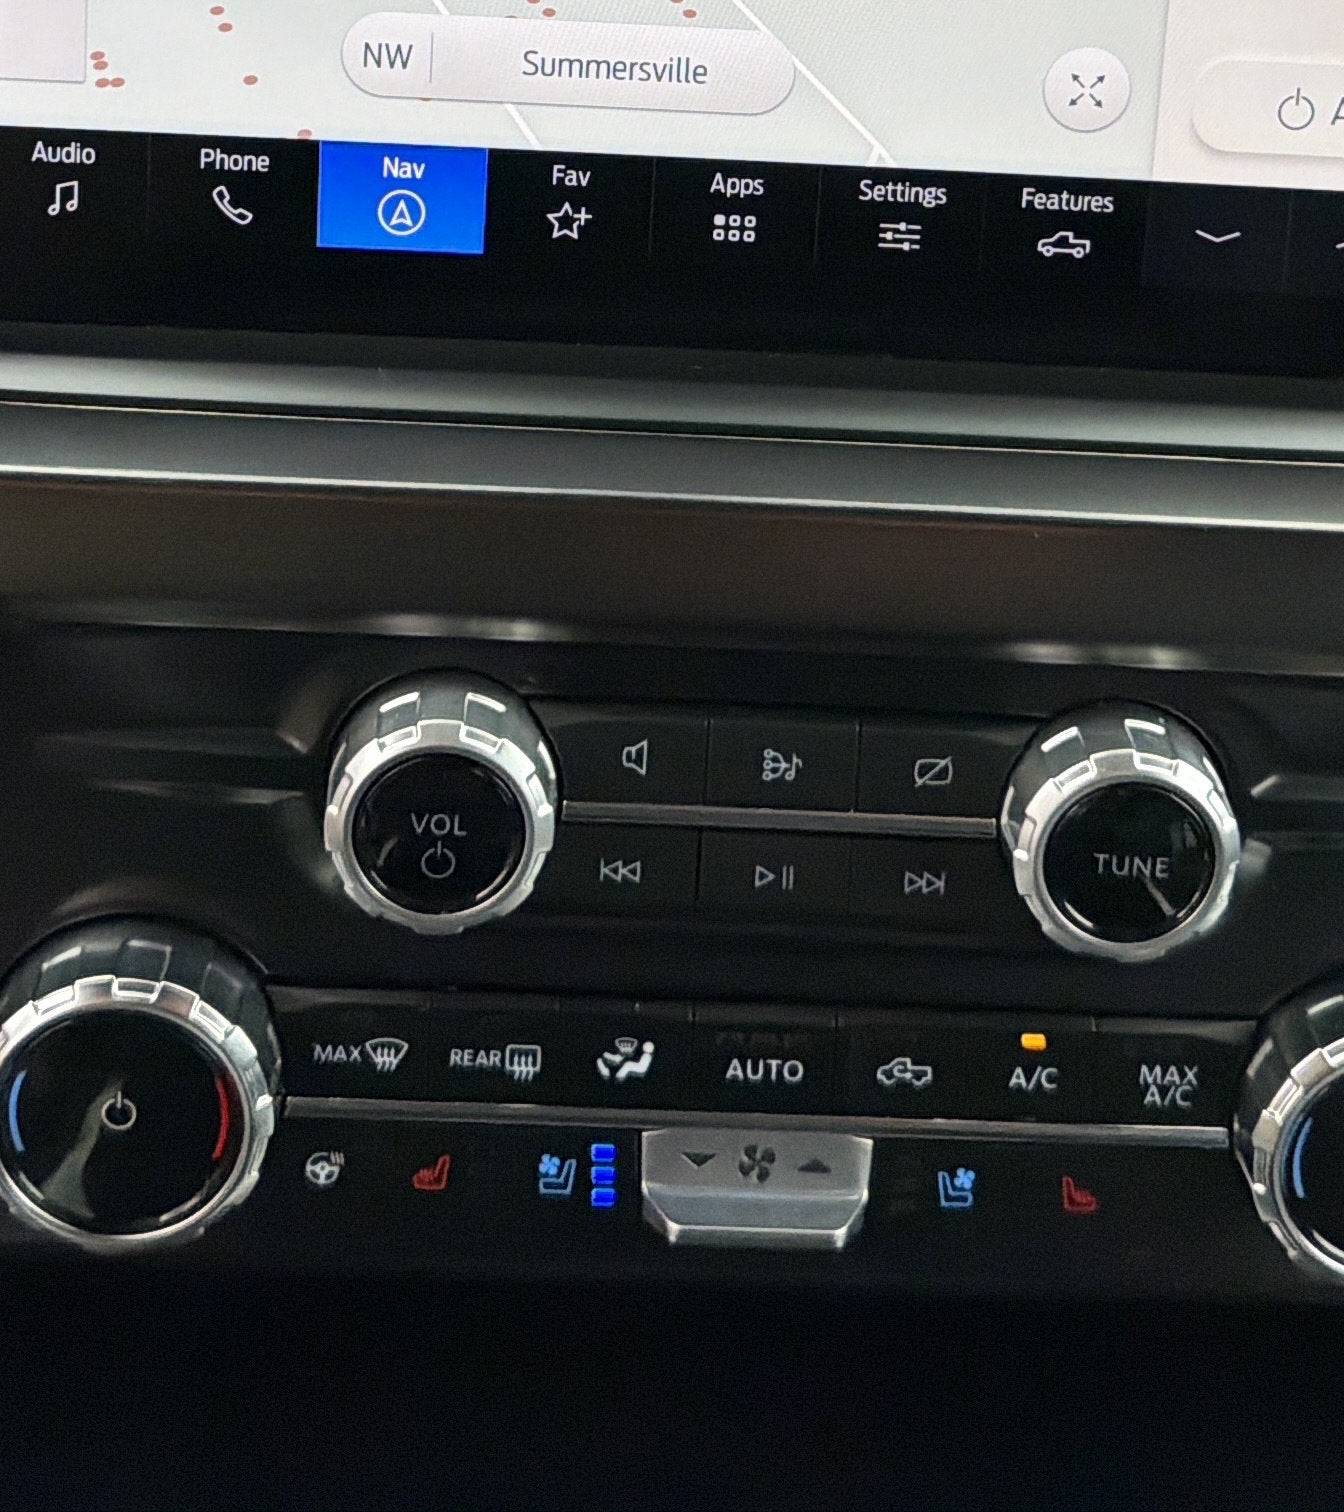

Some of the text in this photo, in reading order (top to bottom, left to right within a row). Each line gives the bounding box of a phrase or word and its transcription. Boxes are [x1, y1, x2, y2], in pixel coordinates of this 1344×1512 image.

[362, 42, 414, 70] NW
[522, 50, 708, 84] Summersville
[31, 142, 96, 164] Audio
[199, 148, 270, 173] Phone
[382, 156, 426, 180] Nav
[551, 164, 591, 187] Fav
[710, 171, 765, 197] Apps
[858, 179, 947, 206] Settings
[1021, 186, 1114, 213] Features
[410, 812, 467, 837] VOL
[1094, 851, 1171, 879] TUNE
[312, 1043, 362, 1063] MAX
[450, 1048, 502, 1069] REAR
[725, 1057, 805, 1083] AUTO
[1009, 1066, 1059, 1090] A/C
[1139, 1064, 1198, 1086] MAX
[1144, 1086, 1192, 1109] A/C
